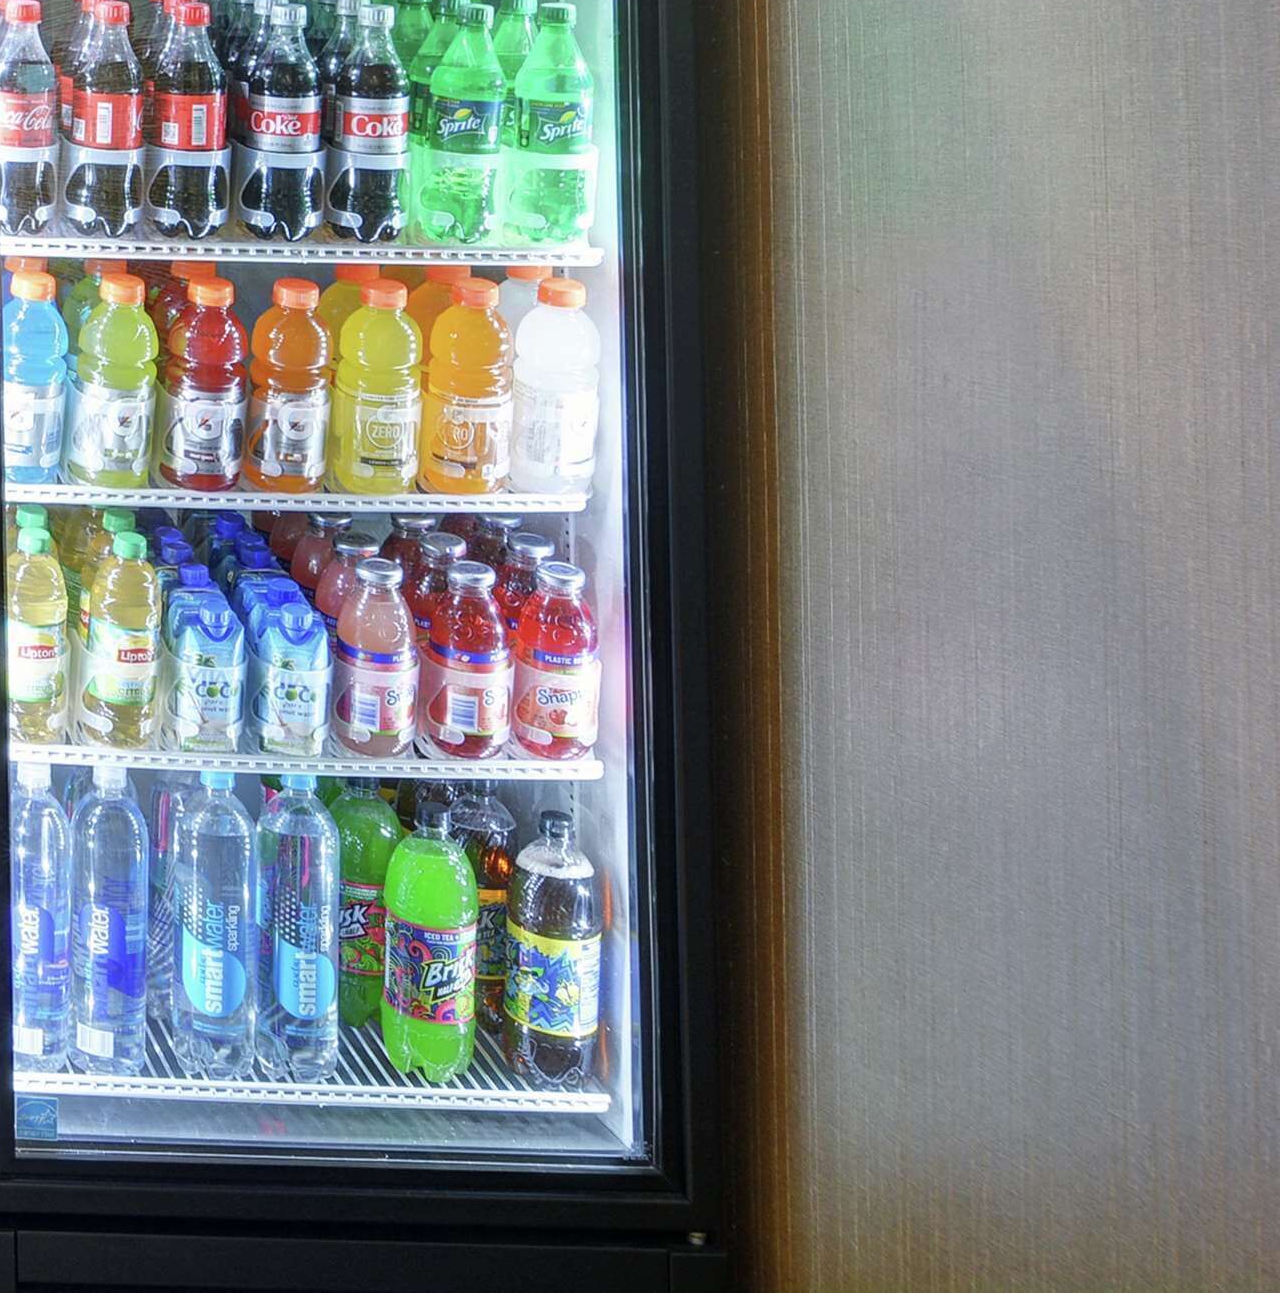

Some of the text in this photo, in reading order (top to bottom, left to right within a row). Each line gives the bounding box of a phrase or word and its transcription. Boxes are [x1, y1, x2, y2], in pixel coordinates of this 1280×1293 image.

[251, 111, 301, 136] Coke
[351, 115, 404, 136] Coke
[436, 113, 482, 139] Sprite
[539, 117, 587, 142] Sprite
[20, 646, 58, 659] Lipton
[120, 650, 154, 663] Lipto
[544, 655, 572, 665] PLASTIC
[537, 688, 579, 707] Snap
[225, 905, 240, 952] sparkling
[424, 932, 454, 941] ICED TEA
